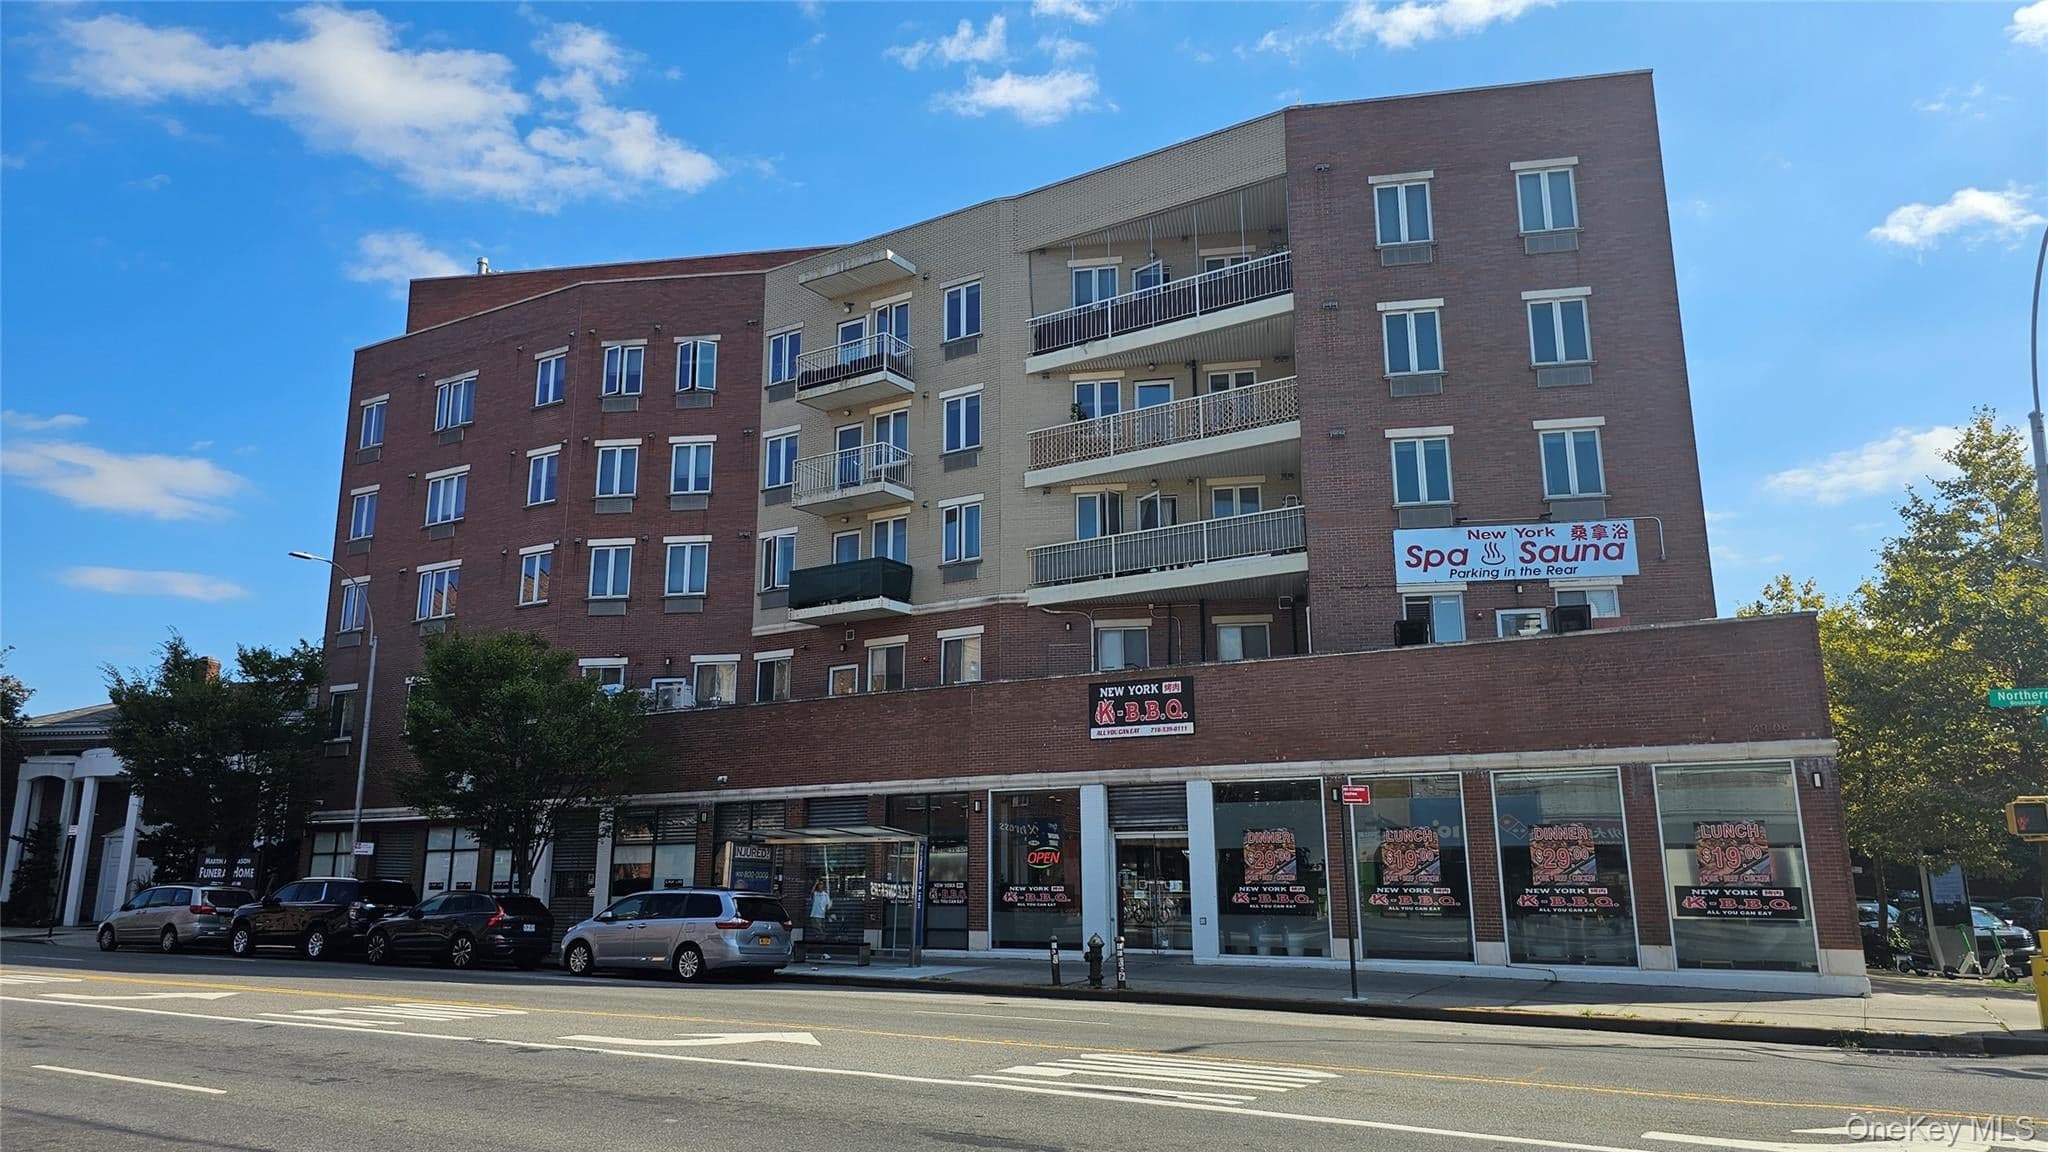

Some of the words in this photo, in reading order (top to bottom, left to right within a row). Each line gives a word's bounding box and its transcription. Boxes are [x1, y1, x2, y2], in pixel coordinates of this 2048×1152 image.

[1467, 529, 1506, 540] New
[1514, 527, 1555, 538] York
[1571, 523, 1629, 541] 桑拿浴
[1405, 545, 1469, 572] Spa
[1518, 540, 1625, 564] Sauna
[1449, 568, 1500, 579] Parking
[1504, 567, 1515, 576] in
[1520, 566, 1541, 576] the
[1546, 565, 1578, 575] Rear
[1100, 686, 1124, 697] NEW
[1128, 684, 1159, 695] YORK
[1247, 832, 1291, 843] DINNER
[1385, 830, 1433, 842] LUNCH
[1534, 827, 1588, 840] DINNER
[1701, 824, 1760, 839] LUNCH
[1027, 852, 1060, 864] OPEN
